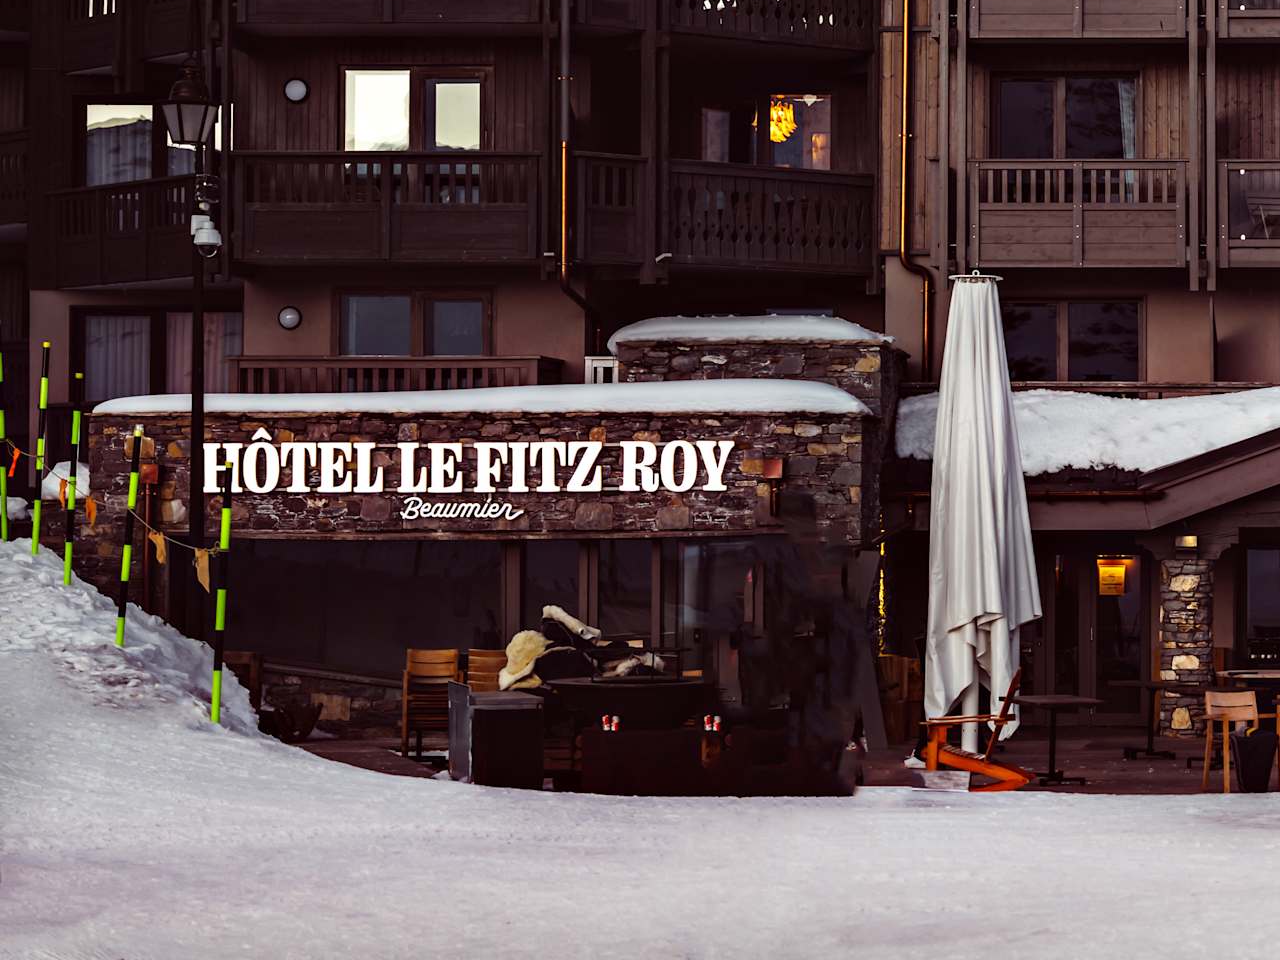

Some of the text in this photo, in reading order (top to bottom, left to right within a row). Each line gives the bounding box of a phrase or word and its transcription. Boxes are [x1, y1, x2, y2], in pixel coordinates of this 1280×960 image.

[202, 426, 736, 494] HÔTEL LE FITZ ROY
[400, 496, 525, 520] Beaumier
